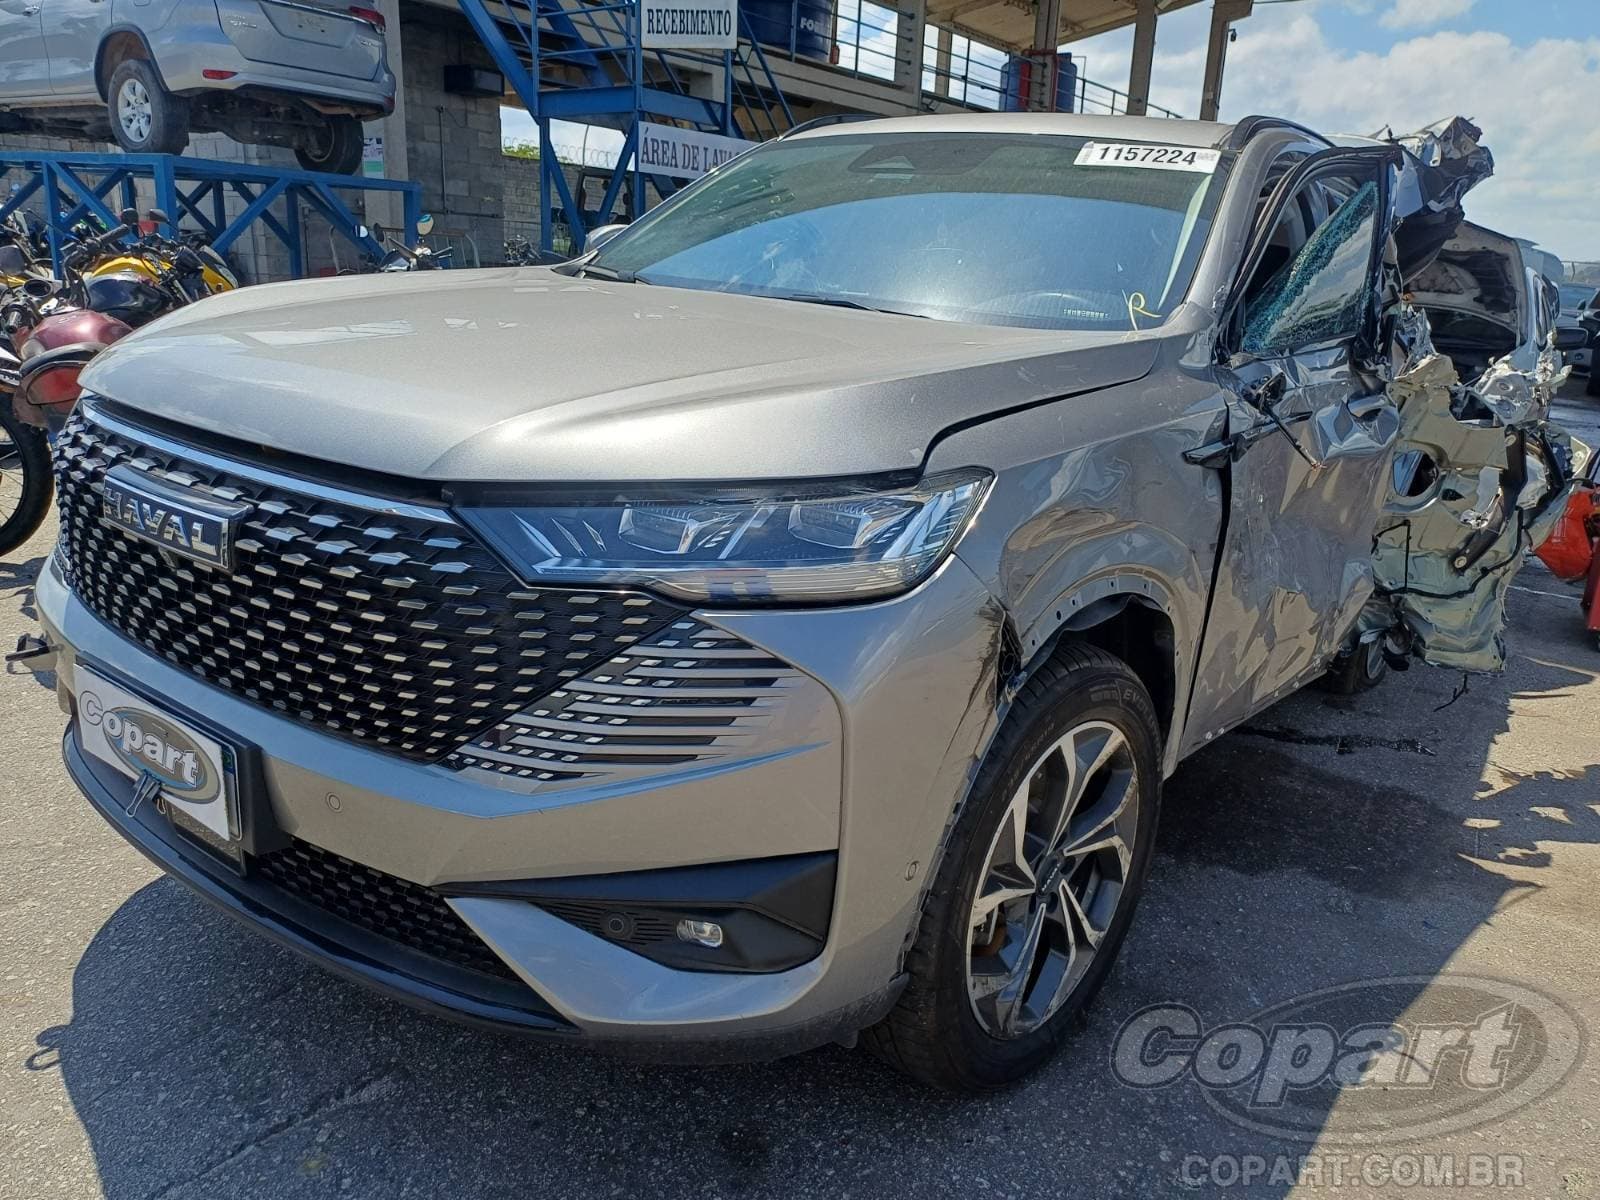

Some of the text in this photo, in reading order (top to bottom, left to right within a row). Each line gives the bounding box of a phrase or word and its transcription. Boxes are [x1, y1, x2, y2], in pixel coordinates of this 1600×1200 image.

[646, 8, 732, 37] RECEBIMENTO
[640, 127, 679, 170] ÁREA
[682, 144, 700, 171] DE
[1099, 145, 1197, 166] 1157224
[103, 487, 217, 557] HAVAL
[80, 690, 200, 788] Copart
